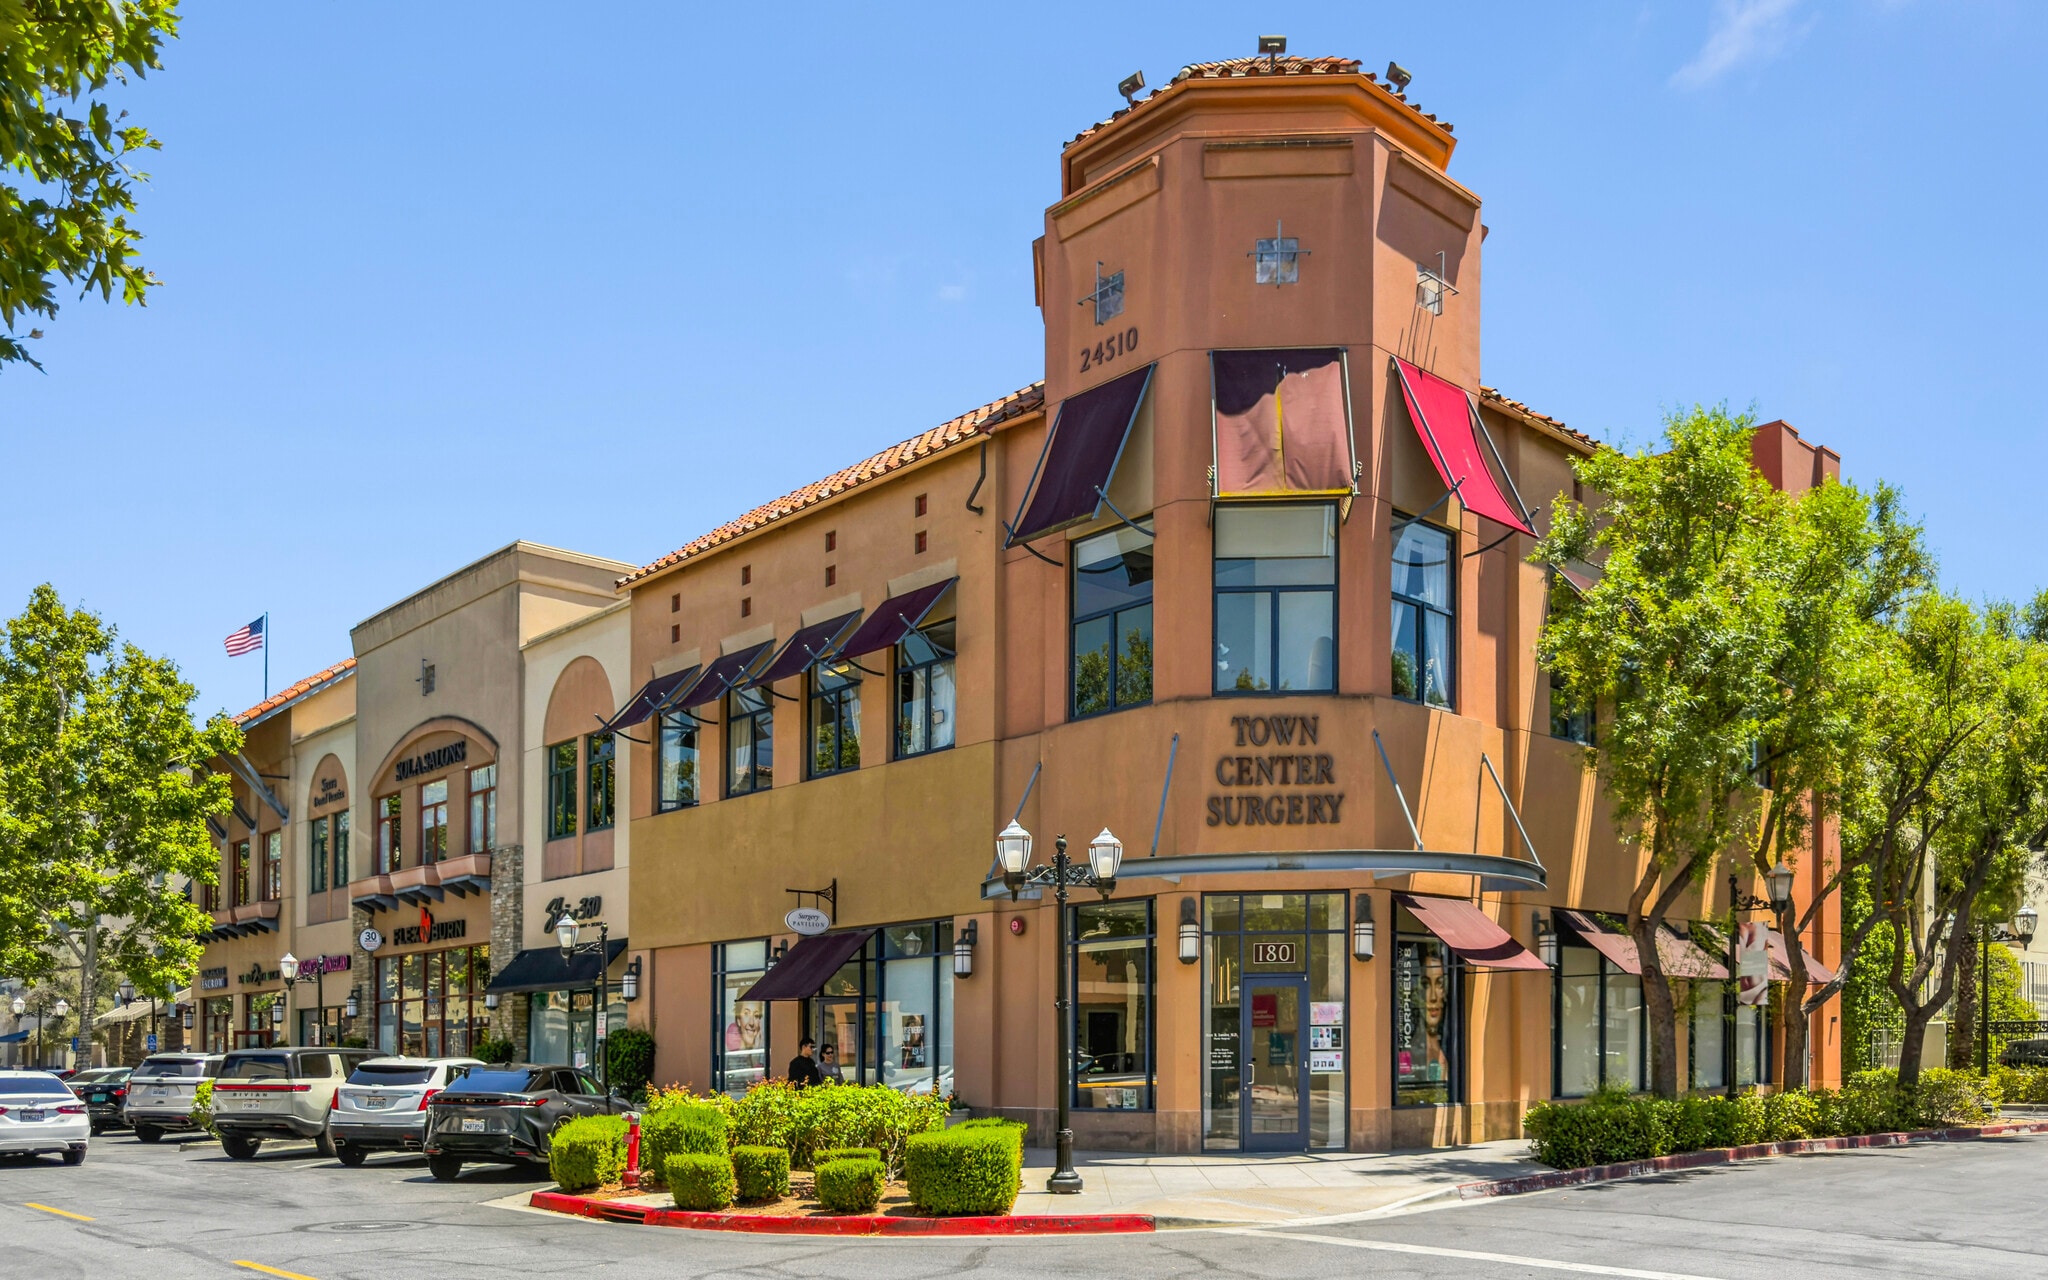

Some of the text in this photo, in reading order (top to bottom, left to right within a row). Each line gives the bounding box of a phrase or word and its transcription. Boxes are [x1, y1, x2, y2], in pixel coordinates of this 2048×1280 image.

[1080, 327, 1138, 373] 24510
[1231, 715, 1319, 747] TOWN
[1215, 753, 1335, 786] CENTER
[1206, 793, 1345, 827] SURGERY
[578, 896, 602, 919] 360
[798, 913, 820, 921] Surgery
[365, 931, 377, 941] 30
[394, 926, 420, 946] FLEX
[431, 919, 466, 941] BURN
[1258, 944, 1290, 962] 180
[201, 977, 226, 990] ESCROW
[1403, 947, 1412, 1049] MORPHEUS 8
